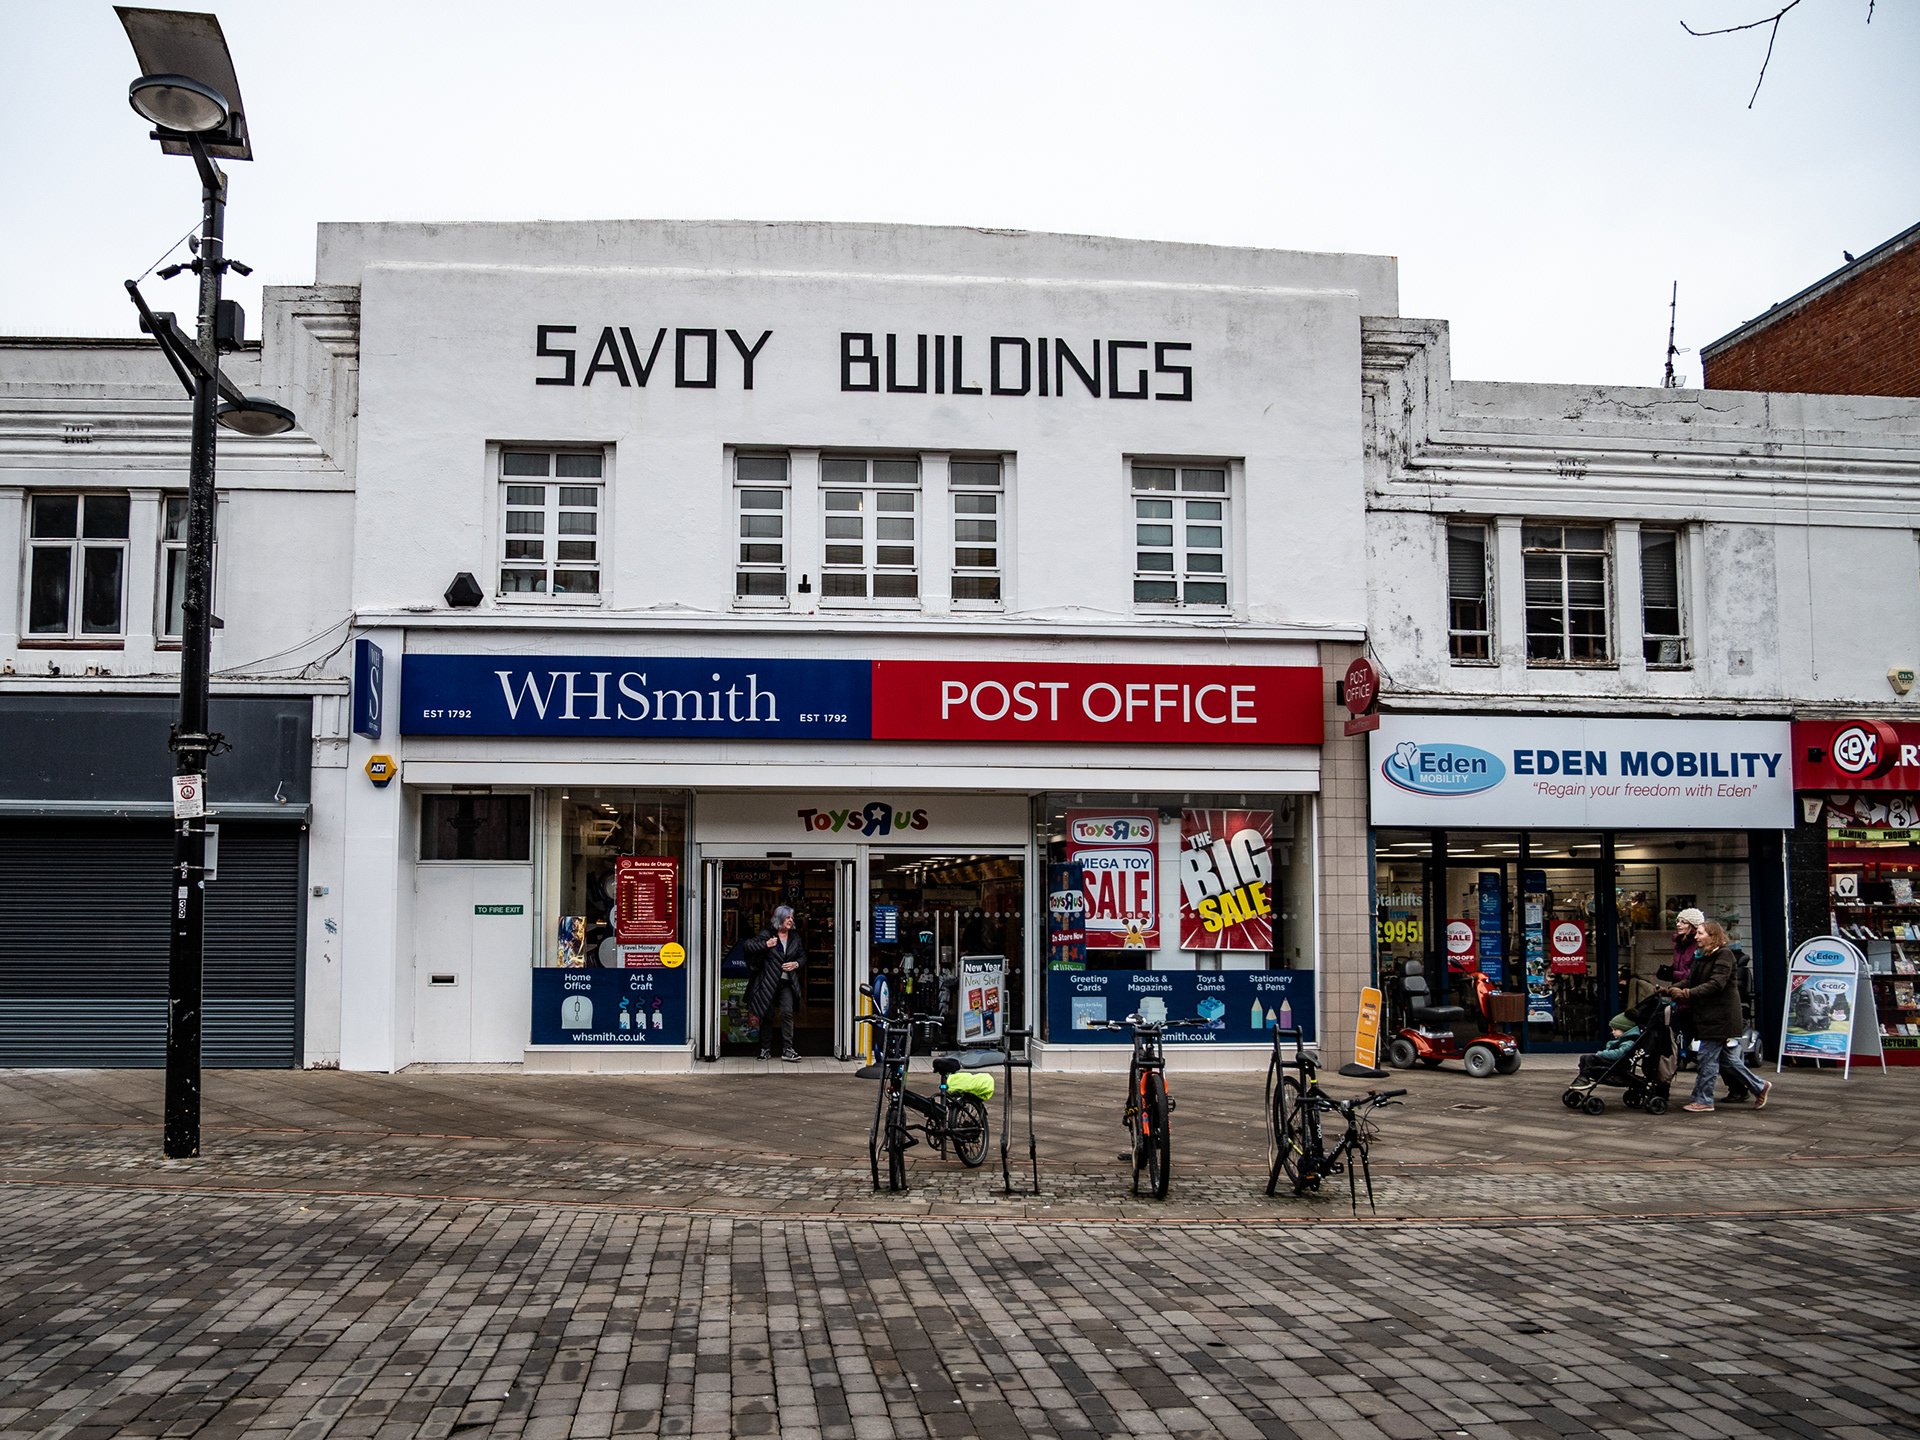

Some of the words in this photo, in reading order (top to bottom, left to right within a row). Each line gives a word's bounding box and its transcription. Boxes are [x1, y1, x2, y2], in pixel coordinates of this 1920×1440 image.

[535, 324, 774, 390] SAVOY
[840, 331, 1193, 402] BUILDINGS
[1350, 668, 1368, 687] POST
[494, 670, 781, 723] WHSmith
[1346, 683, 1371, 702] OFFICE
[941, 680, 1070, 722] POST
[1081, 682, 1258, 724] OFFICE
[423, 709, 444, 719] EST
[447, 709, 472, 719] 1792
[799, 713, 820, 723] EST
[823, 713, 848, 723] 1792
[1419, 752, 1488, 774] Eden
[1513, 749, 1608, 777] EDEN
[1620, 751, 1783, 778] MOBILITY
[371, 764, 387, 773] ADT
[1419, 774, 1469, 784] MOBILITY
[1589, 784, 1620, 799] your
[1624, 782, 1681, 797] freedom
[1685, 784, 1713, 797] with
[1838, 829, 1868, 840] GAMING
[1883, 830, 1912, 840] PHONES
[1187, 830, 1213, 850] THE
[1079, 858, 1119, 869] MEGA
[1123, 858, 1150, 869] TOY
[1180, 828, 1272, 911] BIG
[1084, 870, 1150, 920] SALE
[477, 906, 488, 914] TO
[488, 906, 504, 914] FIRE
[505, 906, 521, 914] EXIT
[1198, 881, 1272, 933] SALE
[1554, 935, 1581, 943] SALE
[1816, 952, 1839, 960] Eden
[965, 963, 983, 973] New
[984, 962, 1001, 972] Year
[564, 973, 592, 982] Home
[629, 973, 645, 982] Art
[646, 973, 654, 982] &
[964, 976, 981, 988] New
[983, 974, 1000, 986] Start
[1070, 974, 1108, 984] Greeting
[1132, 974, 1160, 983] Books
[1161, 974, 1168, 983] &
[1197, 974, 1217, 984] Toys
[1217, 974, 1225, 983] &
[1249, 974, 1293, 984] Stationery
[563, 981, 592, 990] Office
[630, 982, 653, 991] Craft
[1076, 983, 1102, 991] Cards
[1127, 984, 1173, 993] Magazines
[1196, 983, 1226, 991] Games
[1256, 983, 1263, 991] &
[1265, 983, 1286, 991] Pens
[1821, 982, 1847, 990] e-car2
[572, 1032, 646, 1042] whsmith.co.uk
[1154, 1031, 1217, 1042] smith.co.uk
